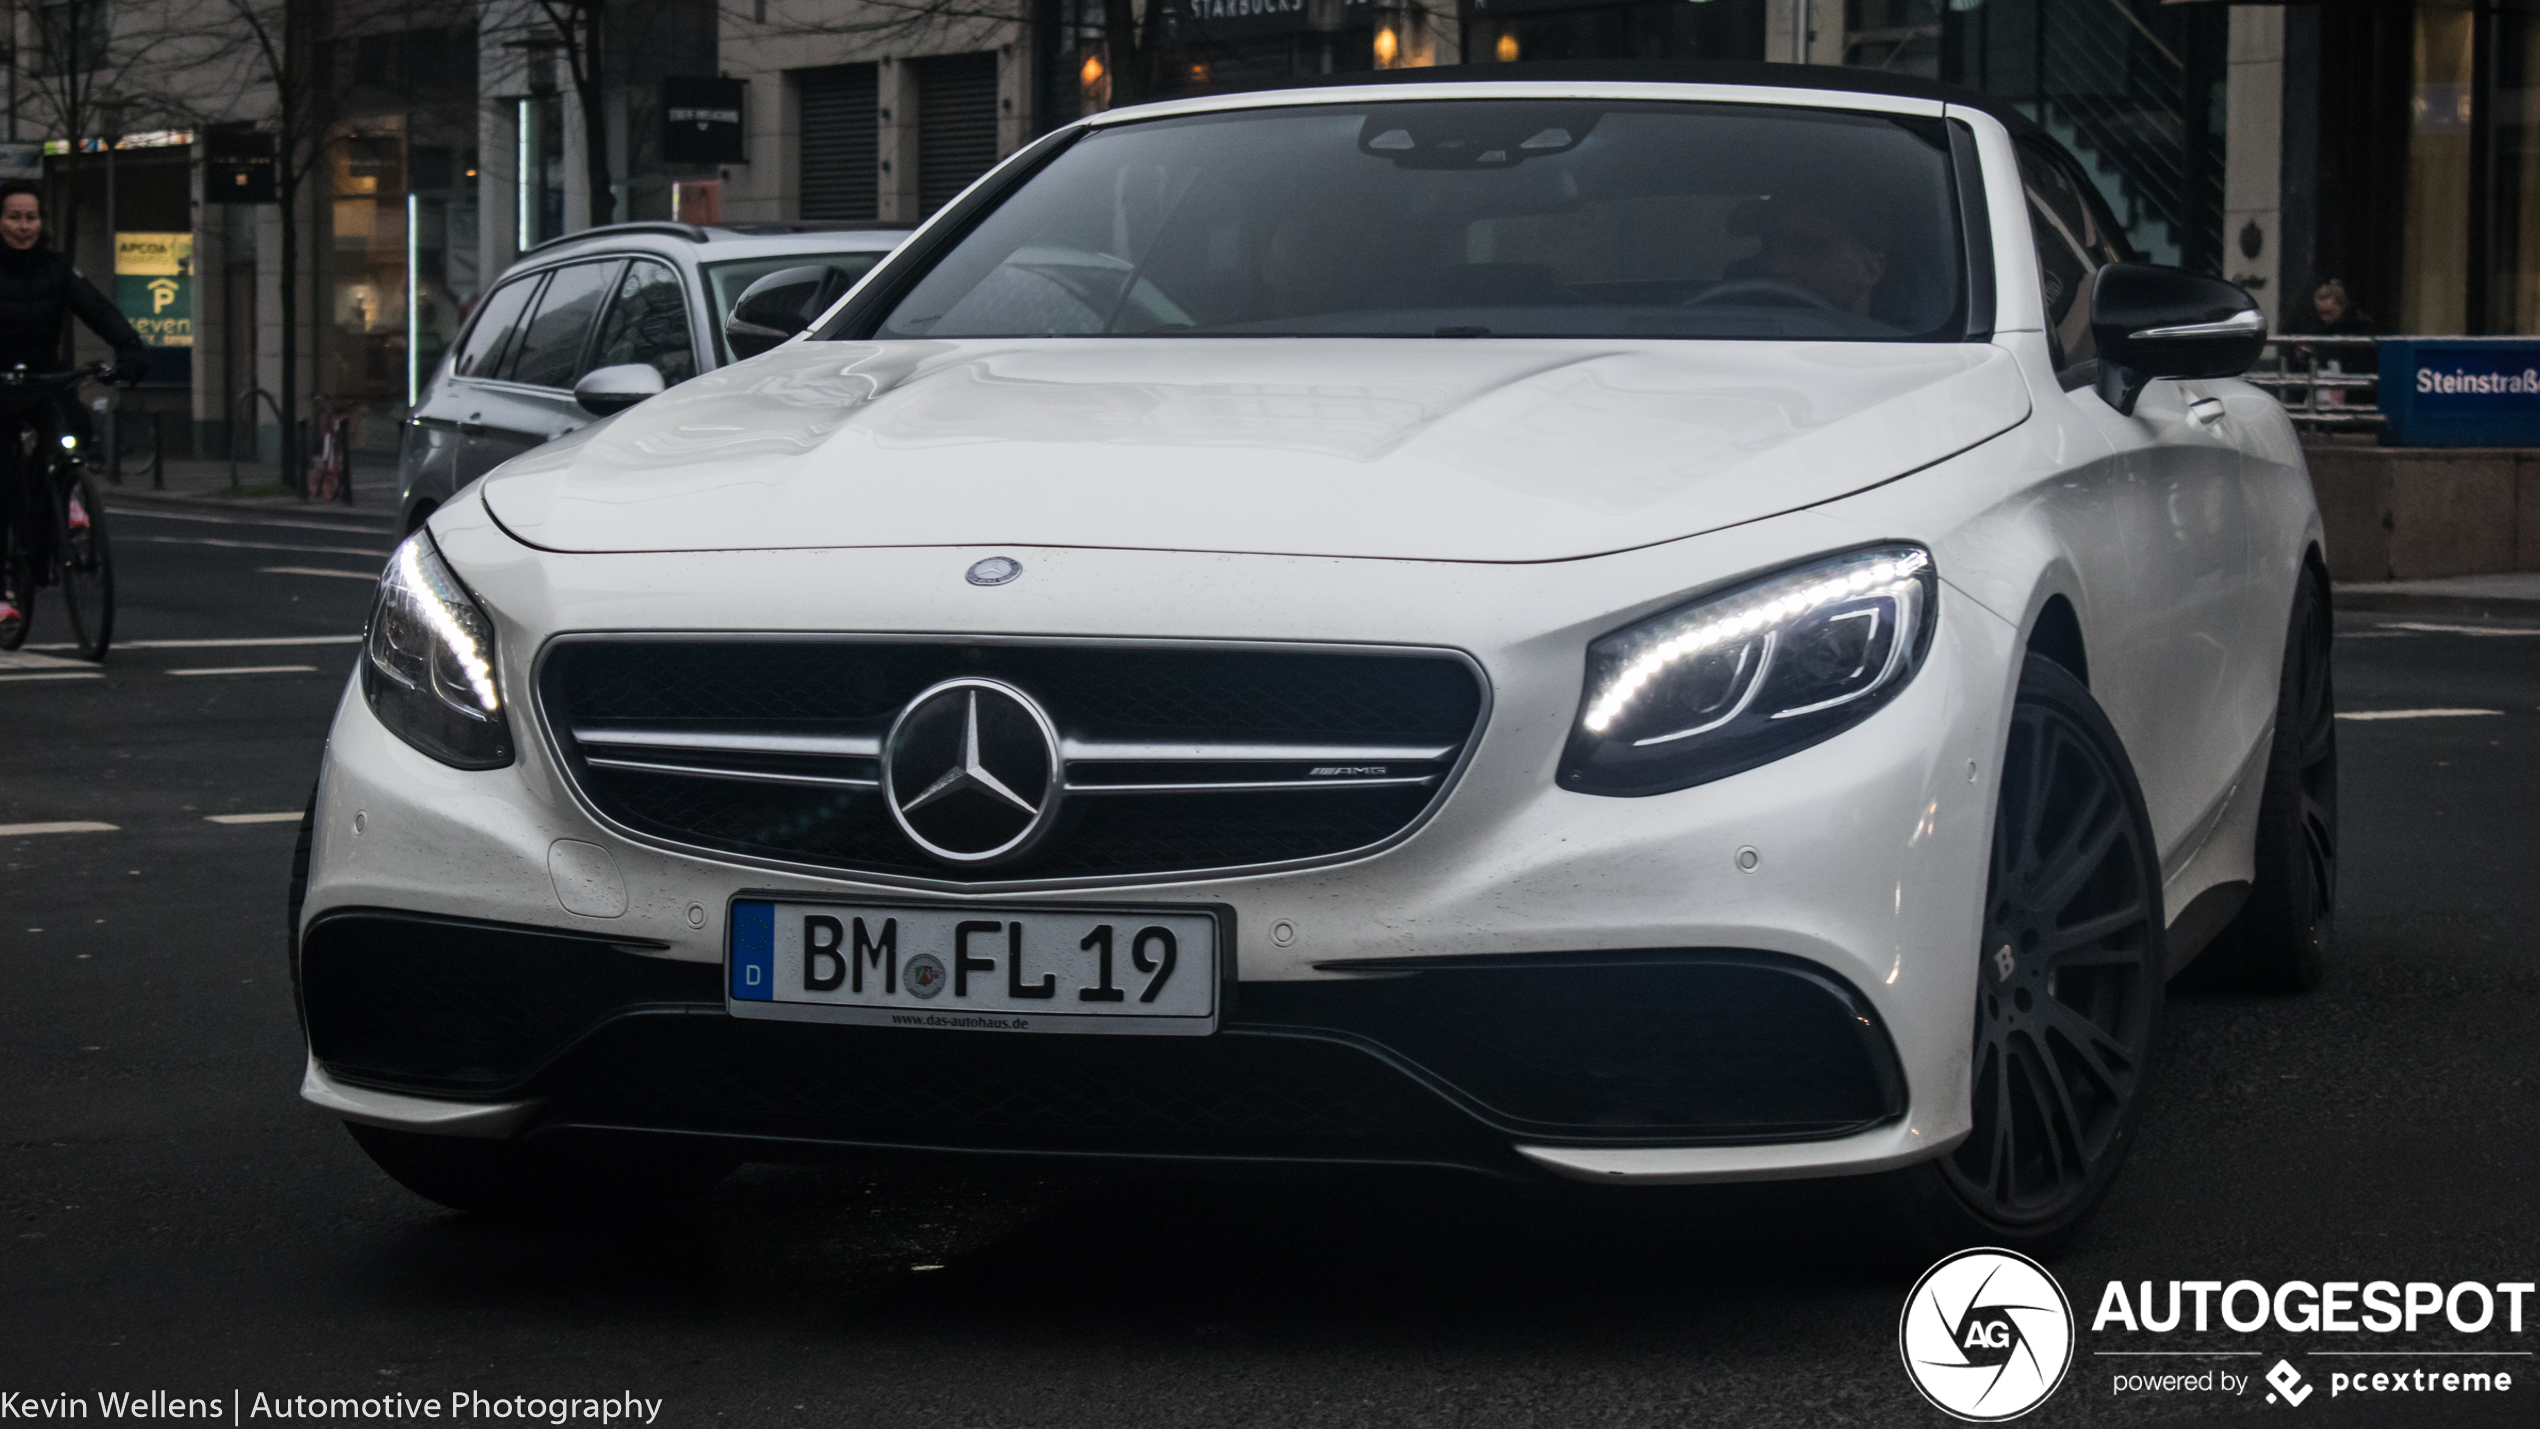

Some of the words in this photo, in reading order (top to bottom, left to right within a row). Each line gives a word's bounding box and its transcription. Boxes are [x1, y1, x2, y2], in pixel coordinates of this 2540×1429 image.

[120, 243, 167, 254] APCOA
[2416, 367, 2540, 394] Steinstraß
[804, 915, 896, 993] BM
[954, 920, 1056, 999] FL
[1079, 925, 1177, 1002] 19
[746, 964, 761, 985] D
[892, 1014, 1029, 1030] www.das-autohaus.de
